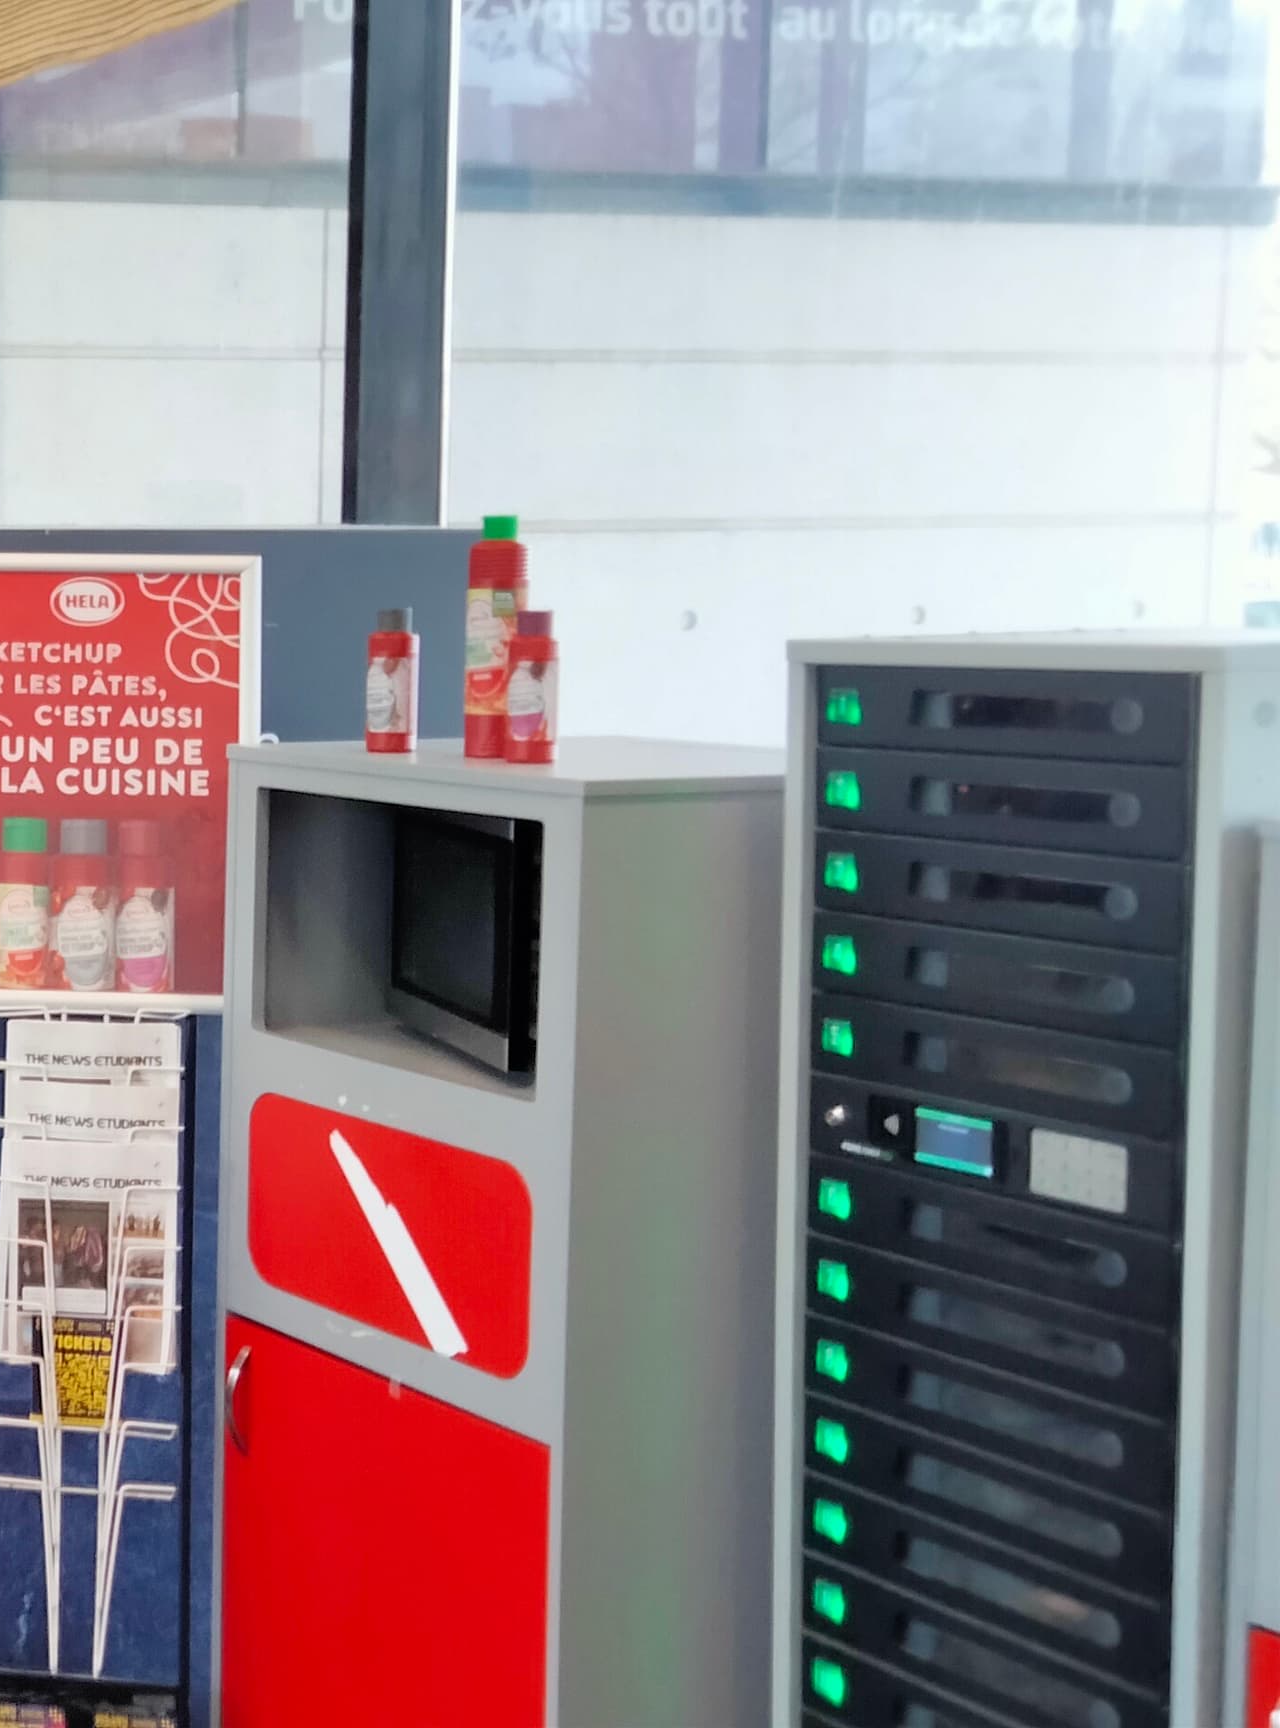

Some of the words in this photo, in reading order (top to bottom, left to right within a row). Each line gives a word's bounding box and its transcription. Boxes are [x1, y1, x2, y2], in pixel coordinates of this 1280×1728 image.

[778, 9, 835, 42] au
[64, 594, 111, 609] HELA
[13, 673, 63, 696] LES
[71, 669, 168, 702] PÂTES,
[119, 706, 204, 729] AUSSI
[0, 735, 55, 763] UN
[68, 736, 141, 766] PEU
[154, 737, 204, 766] DE
[0, 766, 45, 795] LA
[55, 767, 211, 798] CUISINE
[25, 1053, 51, 1065] THE
[52, 1054, 91, 1067] NEWS
[94, 1055, 163, 1067] ETUDIANTS
[28, 1112, 53, 1126] THE
[55, 1116, 94, 1129] NEWS
[51, 1176, 90, 1188] NEWS
[55, 1333, 112, 1352] ICKETS
